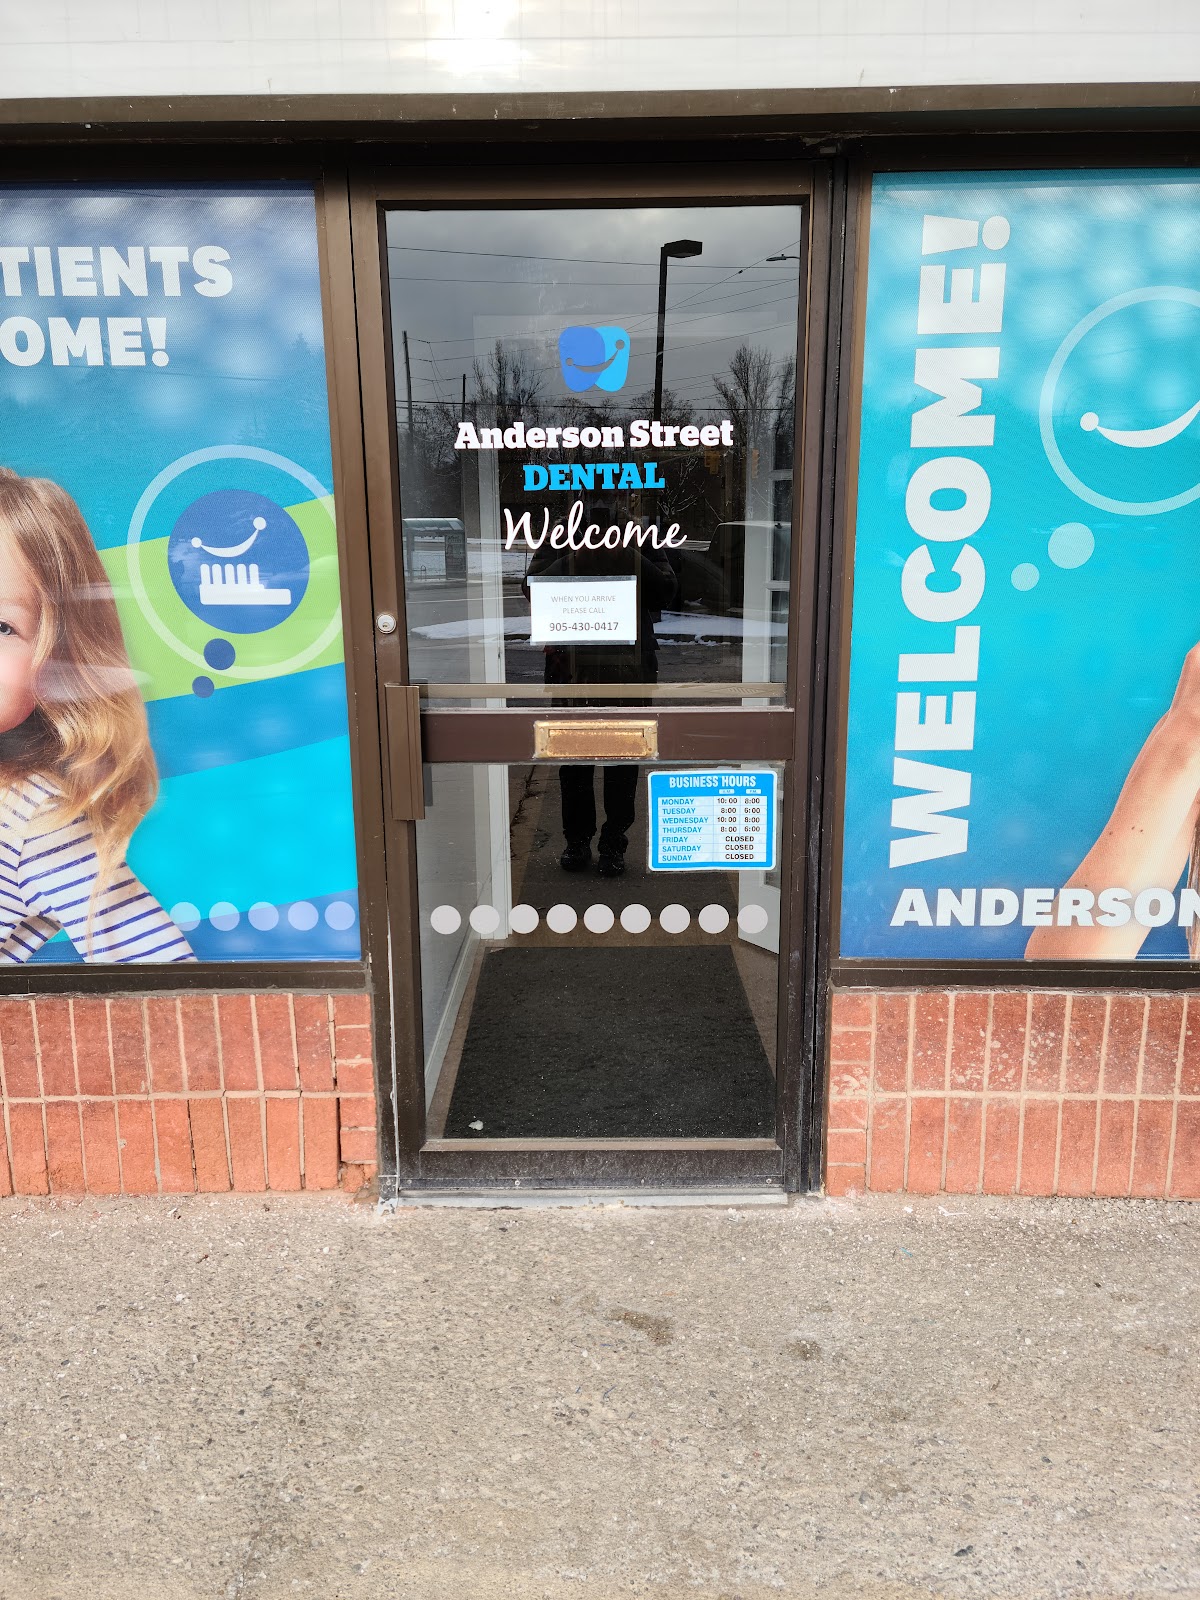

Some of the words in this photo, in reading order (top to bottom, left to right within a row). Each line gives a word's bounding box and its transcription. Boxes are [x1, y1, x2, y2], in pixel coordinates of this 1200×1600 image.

[0, 245, 233, 298] TIENTS
[0, 316, 170, 367] OME!
[454, 421, 625, 450] Anderson
[629, 419, 734, 448] Street
[522, 462, 666, 492] DENTAL
[503, 500, 688, 551] Welcome
[889, 214, 1011, 869] WELCOME!
[550, 595, 573, 603] WHEN
[549, 621, 619, 632] 905-430-0417
[669, 776, 719, 788] BUSINESS
[721, 775, 757, 788] HOURS
[661, 798, 695, 806] MONDAY
[662, 807, 696, 815] TUESDAY
[662, 816, 709, 825] WEDNESDAY
[662, 826, 702, 834] THURSDAY
[662, 854, 692, 862] SUNDAY
